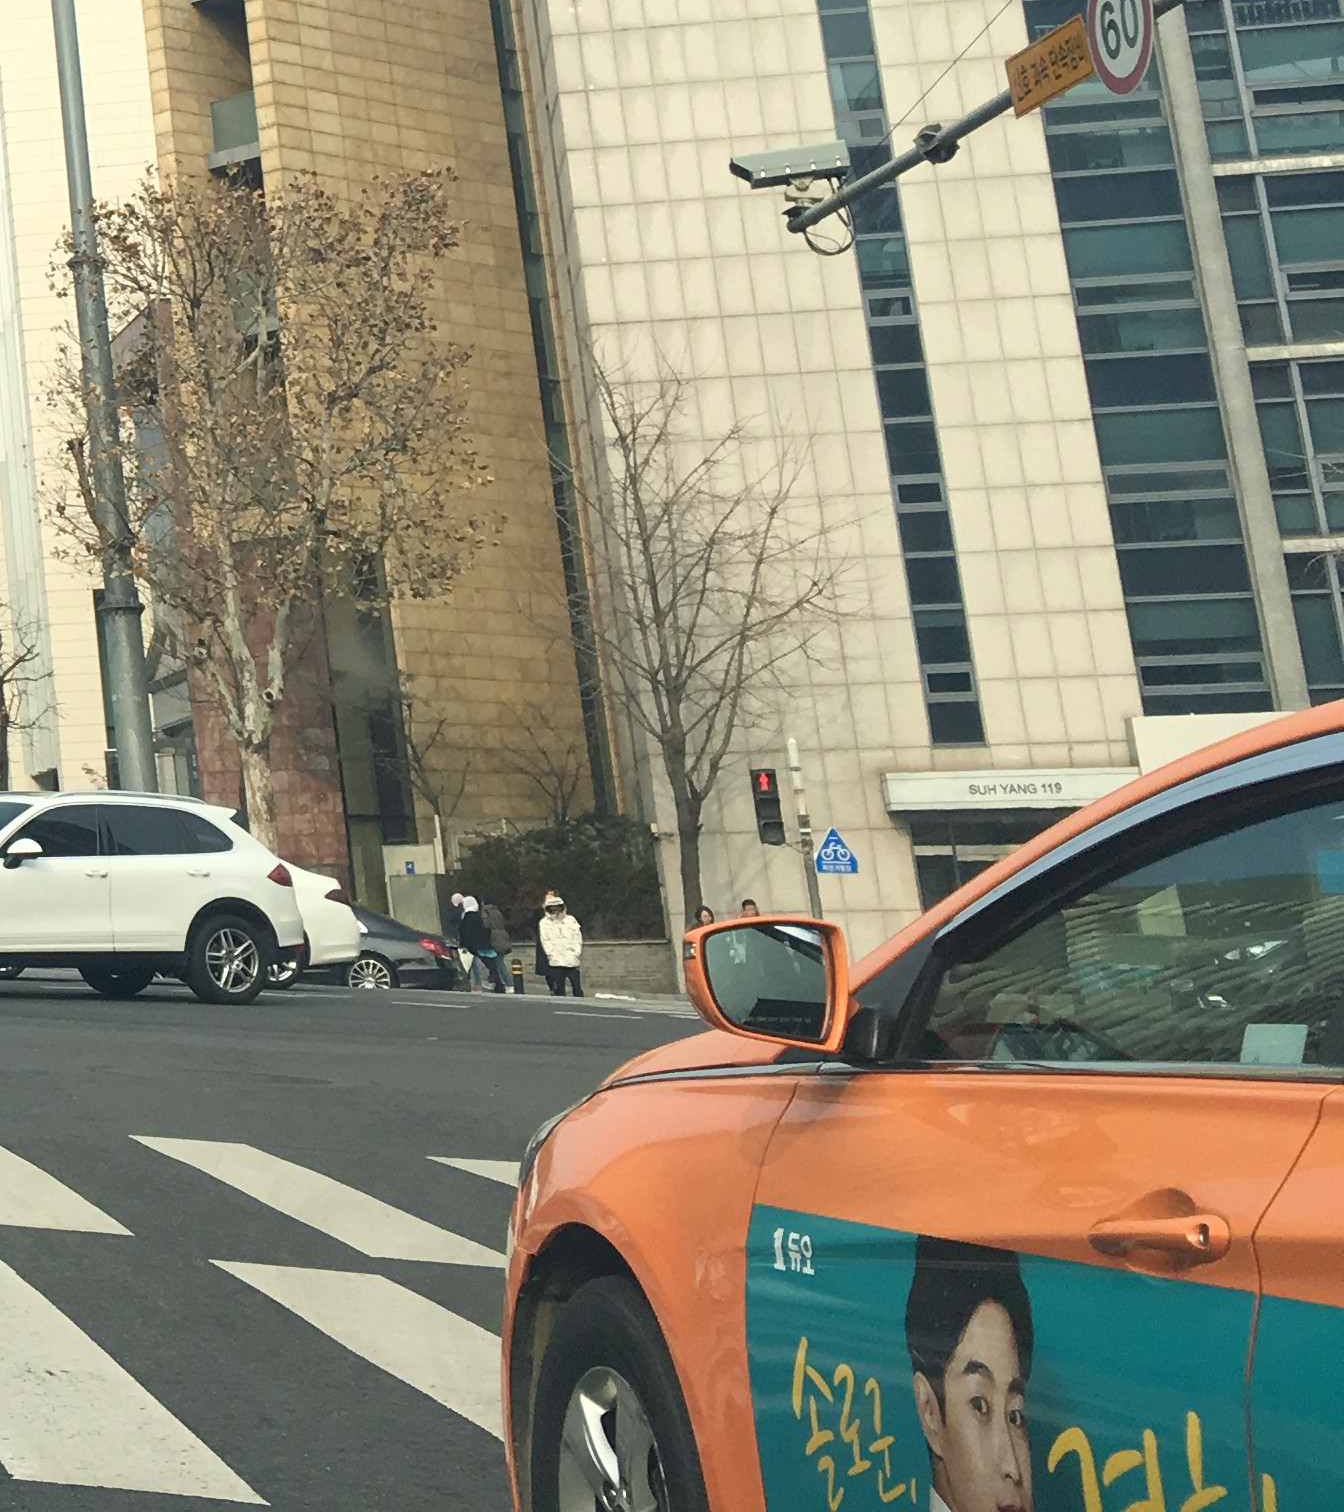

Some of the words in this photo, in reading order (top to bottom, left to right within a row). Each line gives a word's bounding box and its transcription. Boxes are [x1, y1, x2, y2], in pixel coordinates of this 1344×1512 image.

[968, 784, 997, 796] SUH
[1000, 783, 1038, 795] YANG
[1041, 782, 1063, 794] 119
